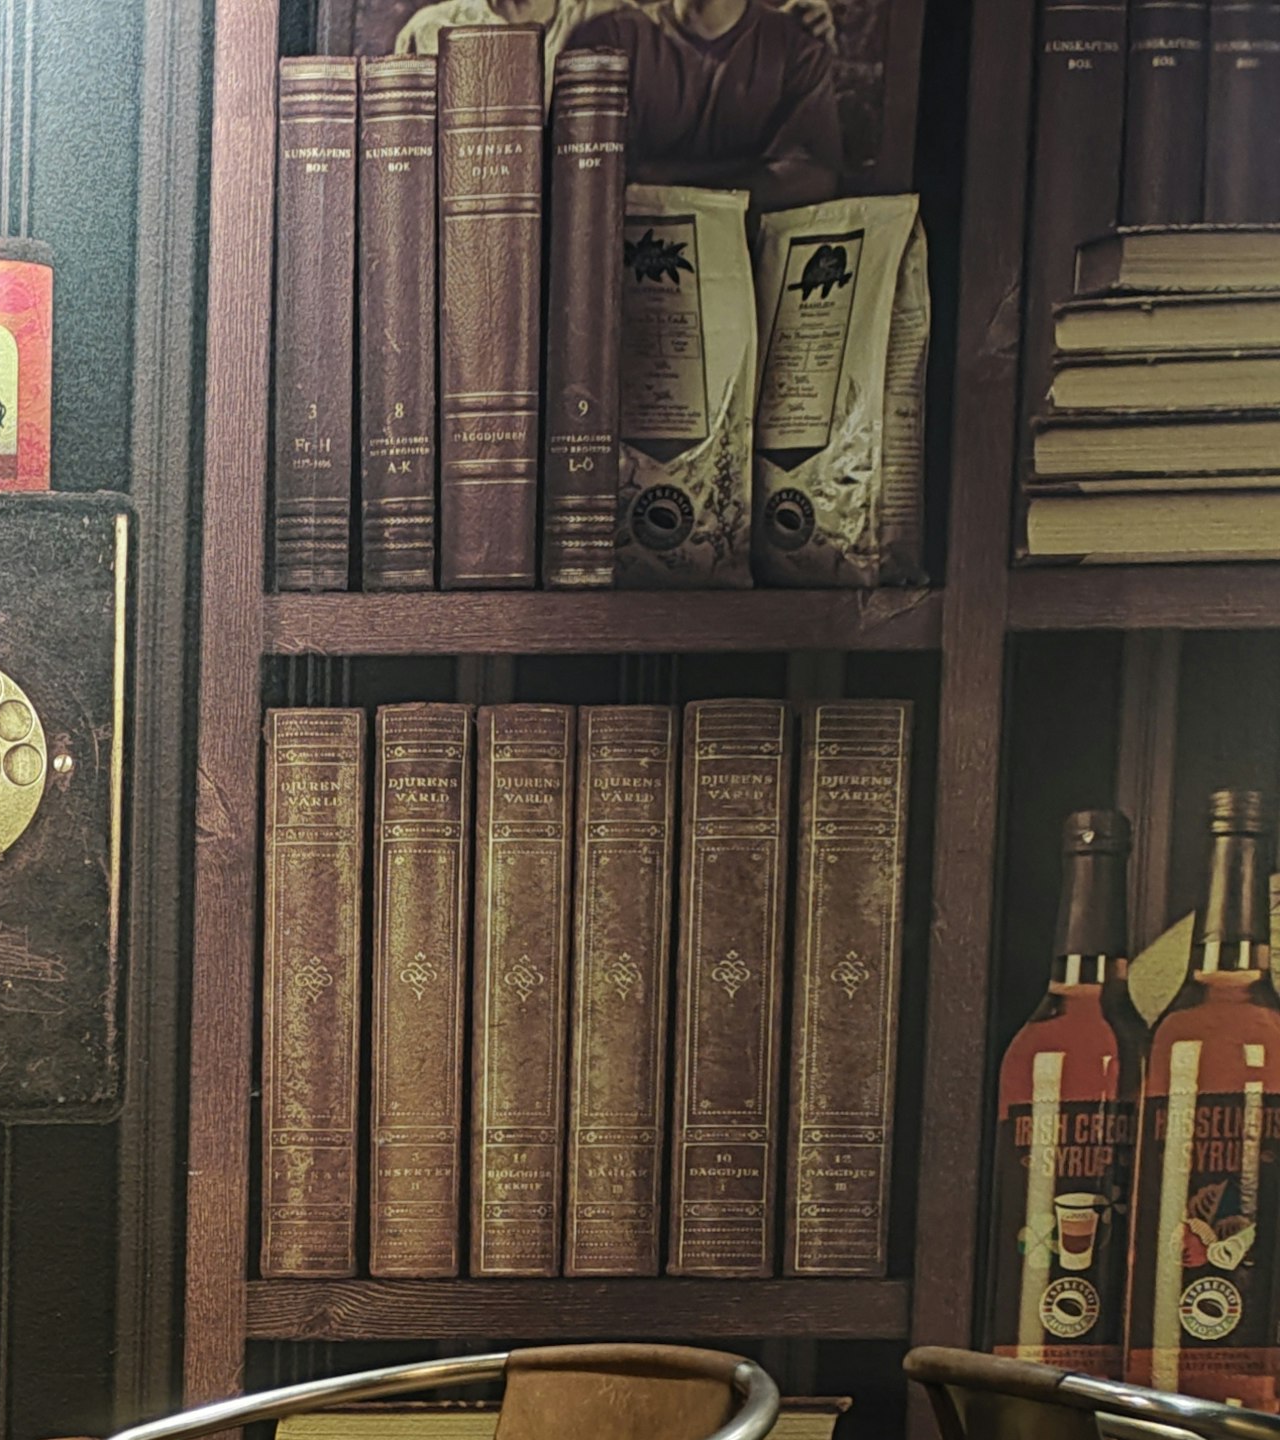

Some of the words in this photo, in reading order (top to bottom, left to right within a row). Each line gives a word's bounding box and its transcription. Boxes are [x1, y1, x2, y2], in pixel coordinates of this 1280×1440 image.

[285, 148, 351, 160] KUNSKAPENS
[365, 146, 433, 158] KUNSKAPENS
[458, 144, 523, 157] SVENSKA
[557, 142, 624, 155] KUNSKAPENS
[306, 162, 328, 173] BOK
[388, 162, 411, 172] BOK
[579, 158, 602, 169] BOK
[472, 166, 511, 178] DJUR
[308, 404, 318, 420] 3
[394, 402, 404, 418] 8
[578, 401, 589, 417] 9
[387, 460, 412, 474] A-K
[388, 777, 458, 790] DJURENS
[496, 777, 560, 790] DJURENS
[593, 777, 662, 790] DJURENS
[700, 774, 772, 787] DJURENS
[820, 775, 891, 787] DJURENS
[1044, 1278, 1095, 1309] ESPRESSO
[1184, 1278, 1237, 1309] ESPRESSO
